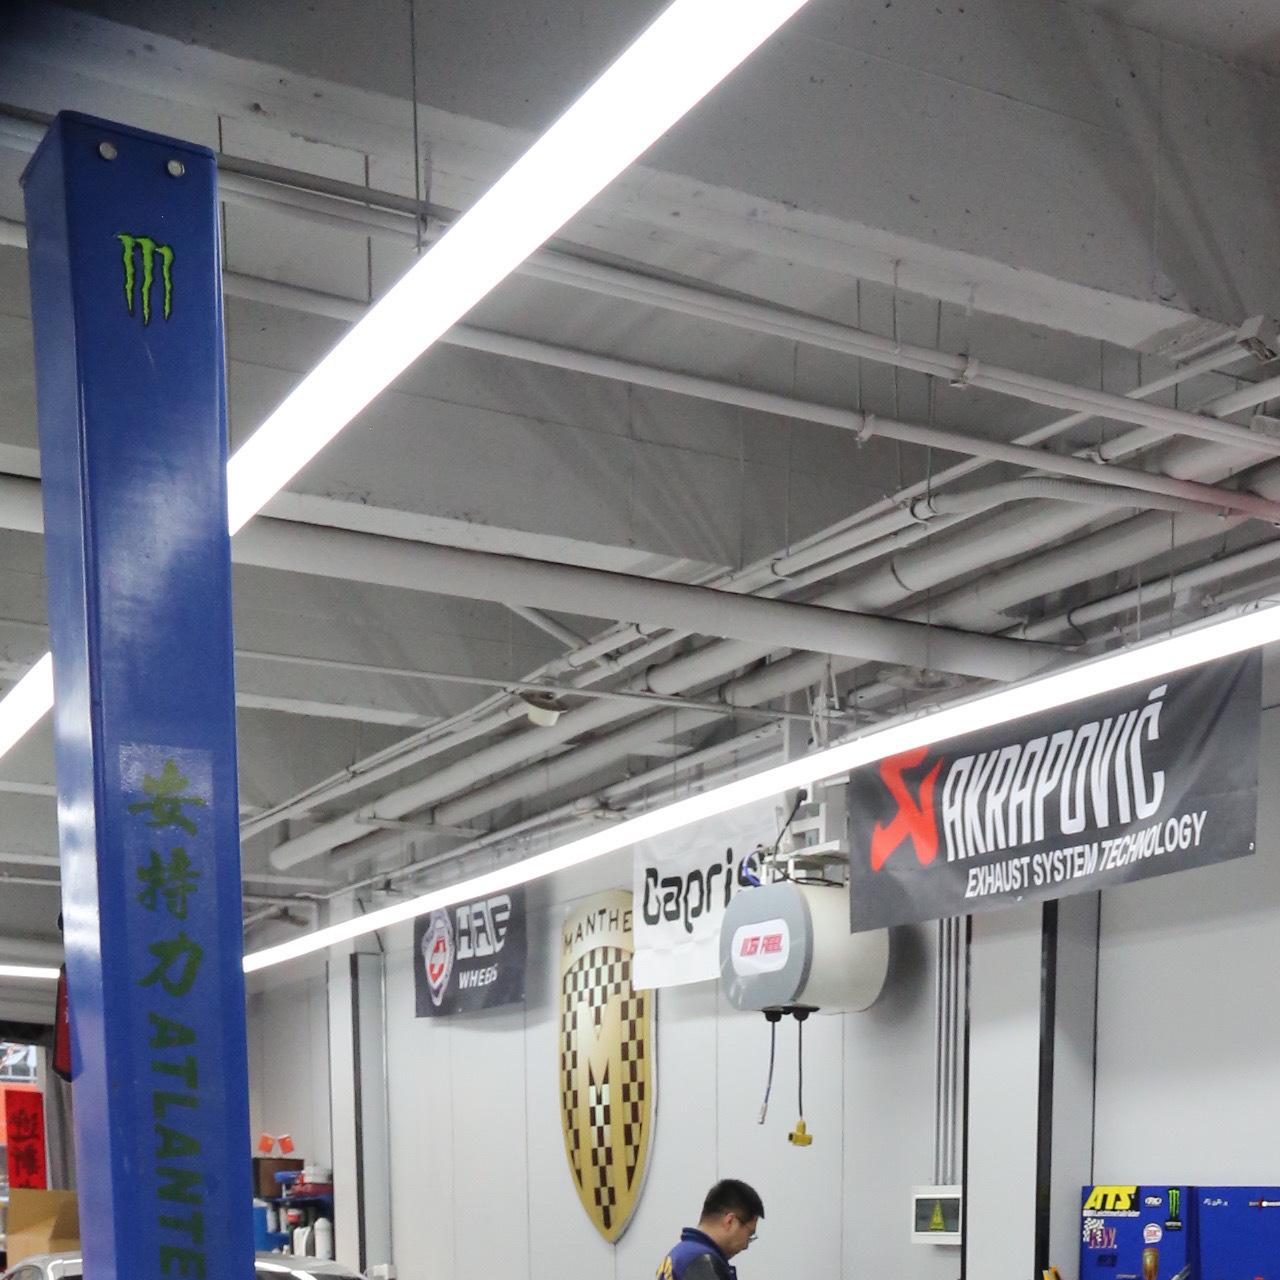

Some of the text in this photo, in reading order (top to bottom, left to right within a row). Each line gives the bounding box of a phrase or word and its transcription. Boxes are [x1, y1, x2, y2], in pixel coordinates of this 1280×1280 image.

[964, 811, 1208, 898] EXHAUST SYSTEM TECHNOLOGY
[563, 908, 633, 956] MANTHE
[1083, 1186, 1137, 1209] ATS
